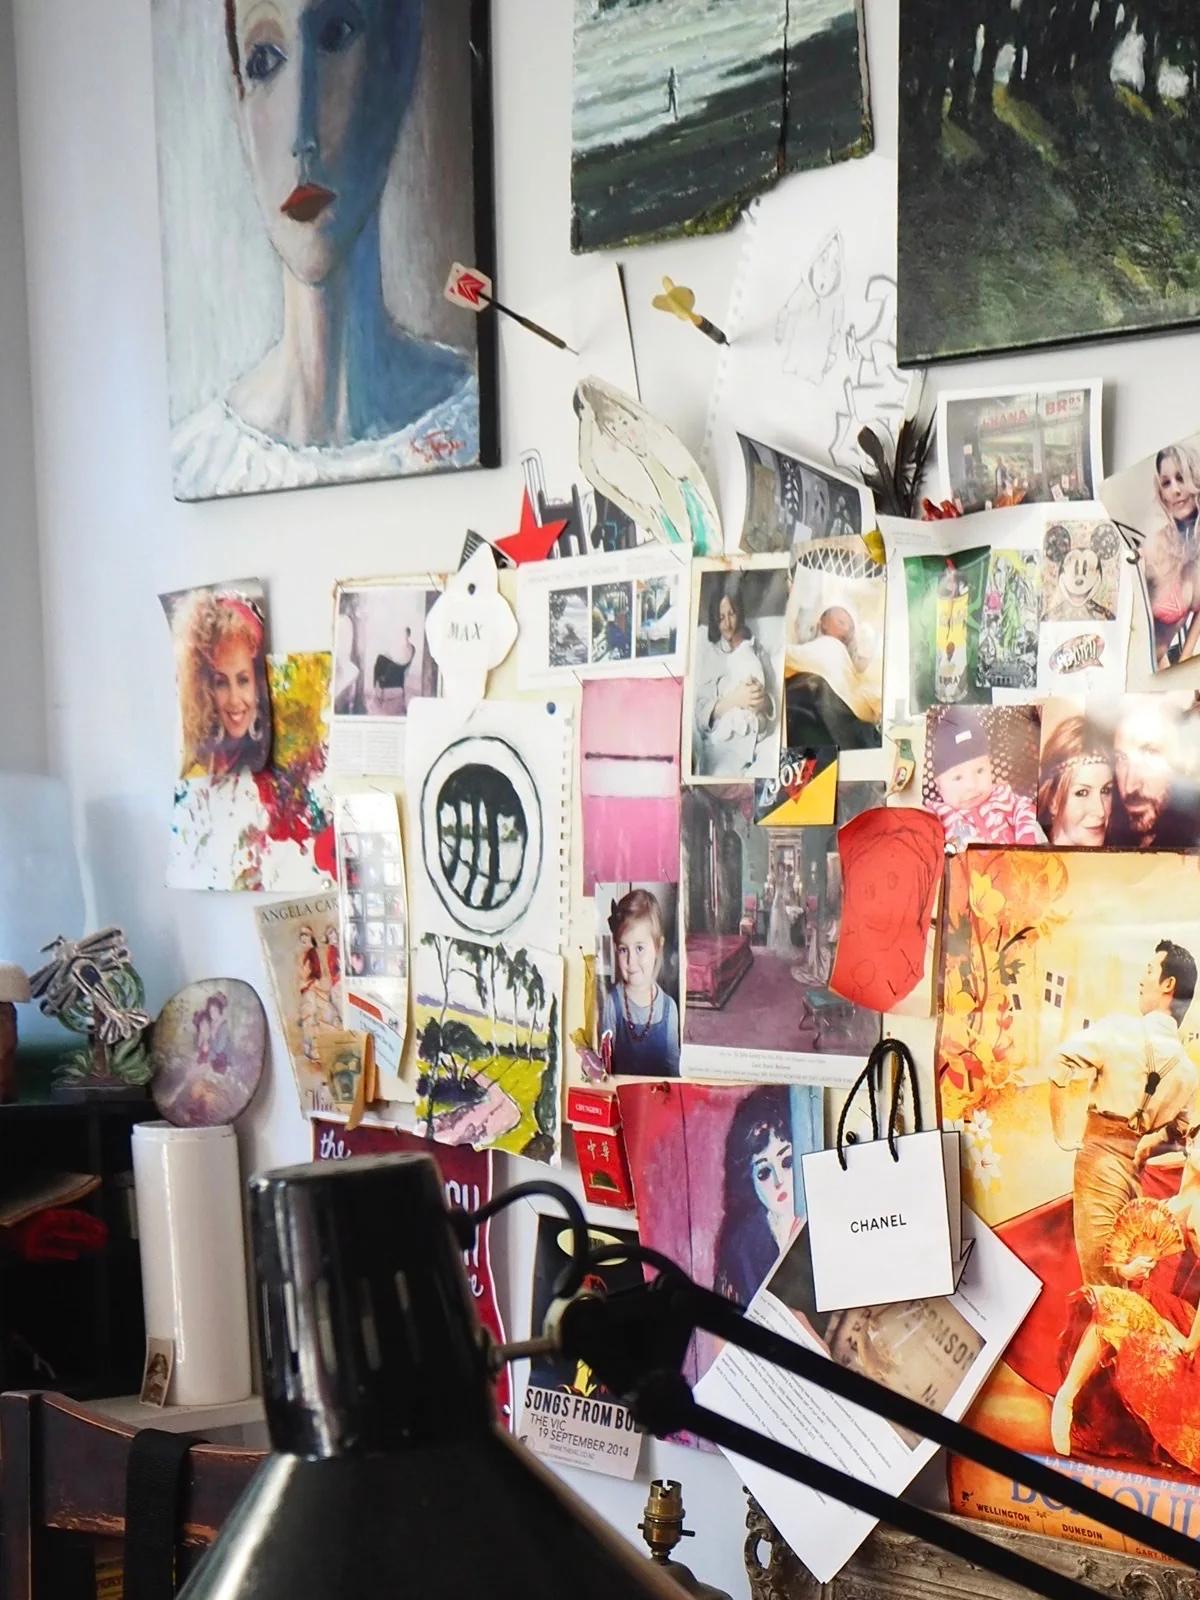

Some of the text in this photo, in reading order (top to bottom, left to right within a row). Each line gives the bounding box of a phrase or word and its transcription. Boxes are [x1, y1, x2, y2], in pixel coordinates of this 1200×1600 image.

[450, 622, 482, 641] MAX
[261, 901, 313, 925] ANGELA
[850, 1213, 907, 1234] CHANEL
[525, 1387, 570, 1418] SONGS
[572, 1398, 613, 1427] FROM
[530, 1412, 567, 1432] THE VIC
[538, 1427, 548, 1438] 19
[550, 1429, 606, 1452] SEPTEMBER
[607, 1442, 629, 1458] 2014
[976, 1503, 1031, 1523] WELLINGTON
[1061, 1523, 1104, 1541] DUNEDIN
